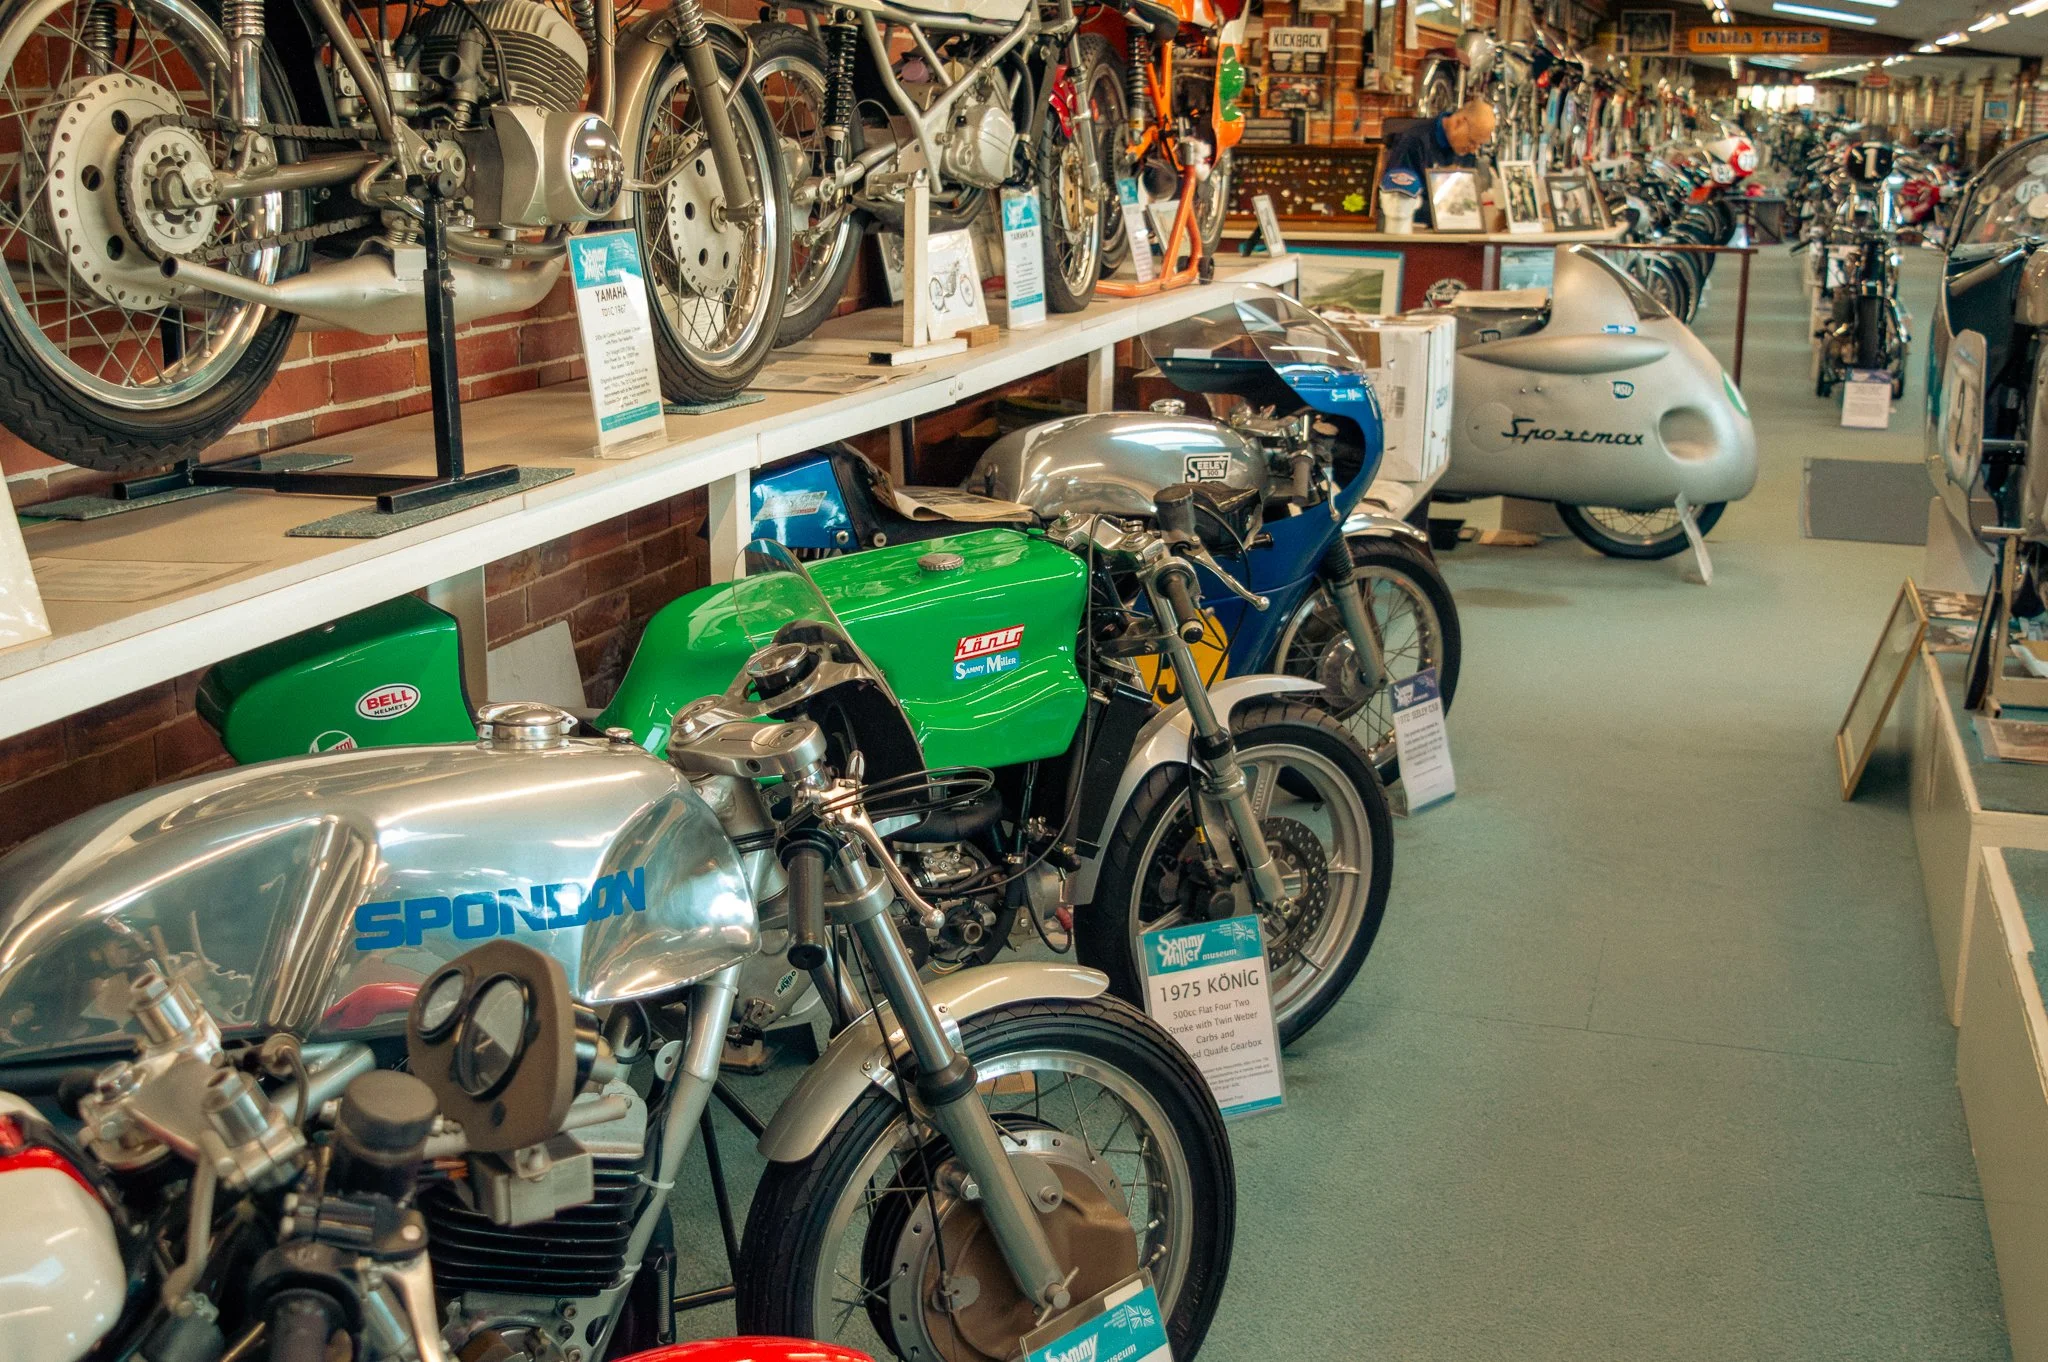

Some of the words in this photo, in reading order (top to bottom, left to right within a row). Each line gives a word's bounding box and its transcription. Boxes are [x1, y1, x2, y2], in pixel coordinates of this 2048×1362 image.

[1273, 33, 1322, 48] KICKBACK
[1697, 31, 1753, 44] INDIA
[1761, 31, 1822, 44] TYRES
[594, 286, 628, 303] YAMAHA
[1501, 417, 1644, 446] Sportmax
[1187, 456, 1227, 482] SEELEY
[366, 689, 413, 711] BELL
[374, 702, 408, 716] HELMETS
[355, 866, 646, 951] SPONDON
[1202, 948, 1238, 961] museum
[1160, 981, 1201, 1003] 1975
[1173, 1009, 1197, 1020] 500cc
[1198, 1005, 1214, 1016] Flat
[1214, 1001, 1232, 1012] Four
[1234, 998, 1250, 1009] Two
[1169, 1022, 1194, 1034] Stroke
[1196, 1019, 1212, 1030] with
[1214, 1015, 1232, 1026] Twin
[1234, 1011, 1258, 1023] Weber
[1196, 1033, 1218, 1044] Carbs
[1220, 1030, 1235, 1041] and
[1204, 1045, 1229, 1058] Quaife
[1231, 1039, 1262, 1052] Gearbox
